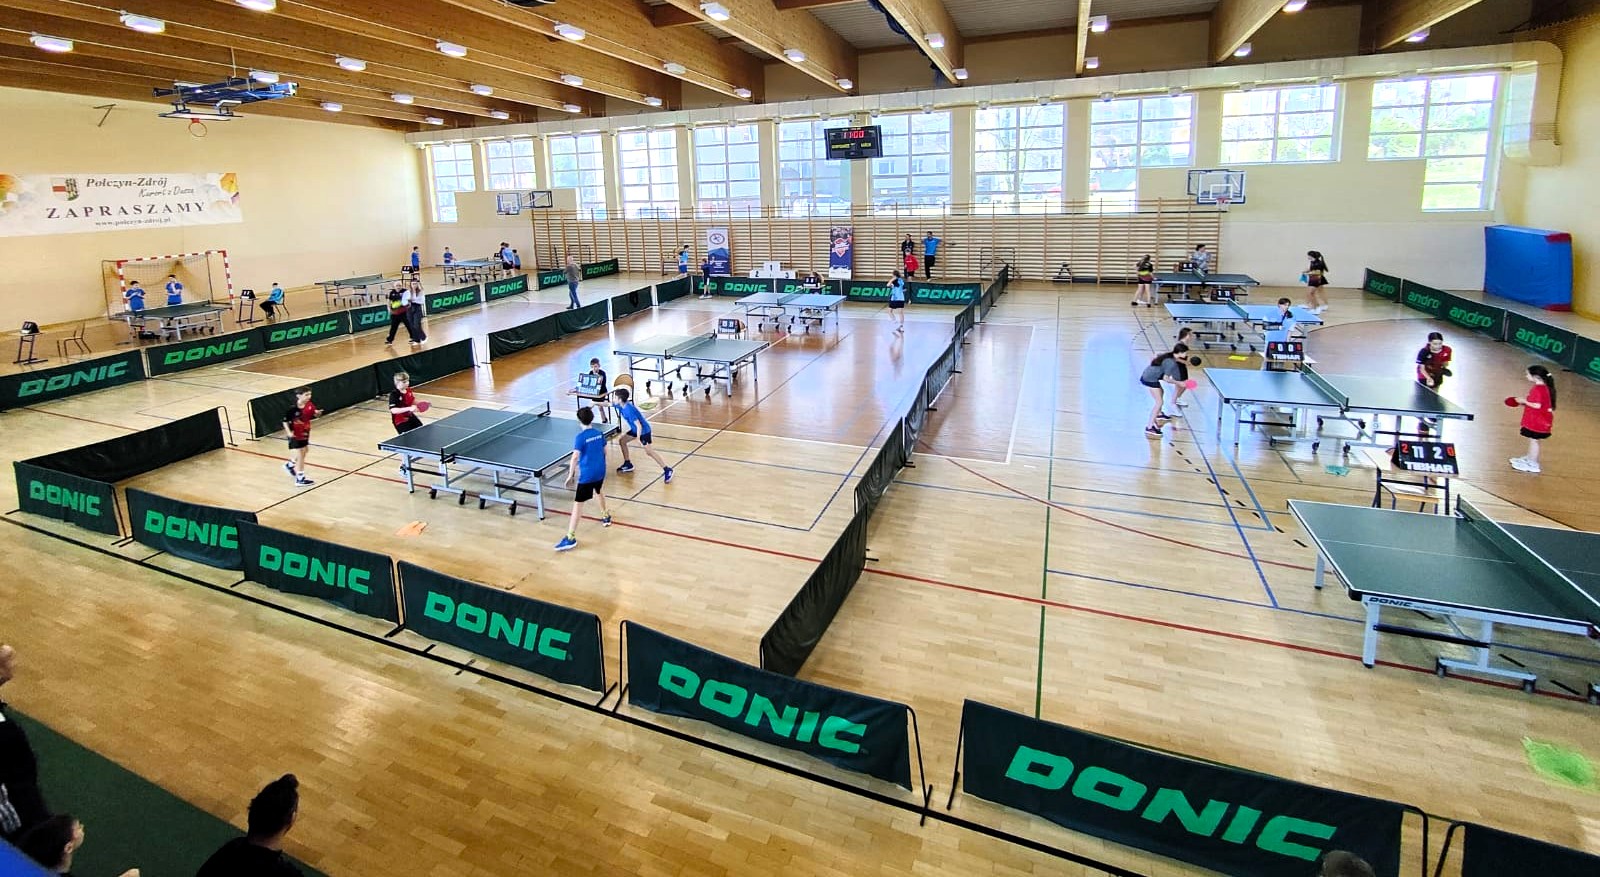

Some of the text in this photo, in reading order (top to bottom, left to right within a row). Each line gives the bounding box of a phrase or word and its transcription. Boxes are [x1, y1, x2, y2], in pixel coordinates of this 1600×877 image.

[47, 201, 205, 219] ZAPRASZAMY
[587, 264, 614, 275] DONIC
[490, 280, 523, 296] DONIC
[543, 274, 566, 285] DON
[724, 282, 768, 293] DONIC
[432, 290, 474, 308] DONIC
[850, 286, 892, 297] DONI
[916, 287, 974, 300] DONIC
[1407, 291, 1441, 309] andro
[1448, 305, 1493, 328] andro
[270, 319, 338, 343] DONIC
[1515, 327, 1564, 354] andro
[163, 337, 249, 366] DONIC
[17, 360, 129, 398] DONIC
[1432, 446, 1444, 460] 2
[1404, 461, 1455, 474] TIBHAR
[29, 480, 102, 516] DONIC
[144, 510, 239, 549] DONIC
[259, 545, 371, 595] DONIC
[1368, 596, 1414, 608] DONIC
[423, 590, 572, 661] DONIC
[657, 660, 869, 754] DONIC
[1004, 745, 1338, 862] DONIC
